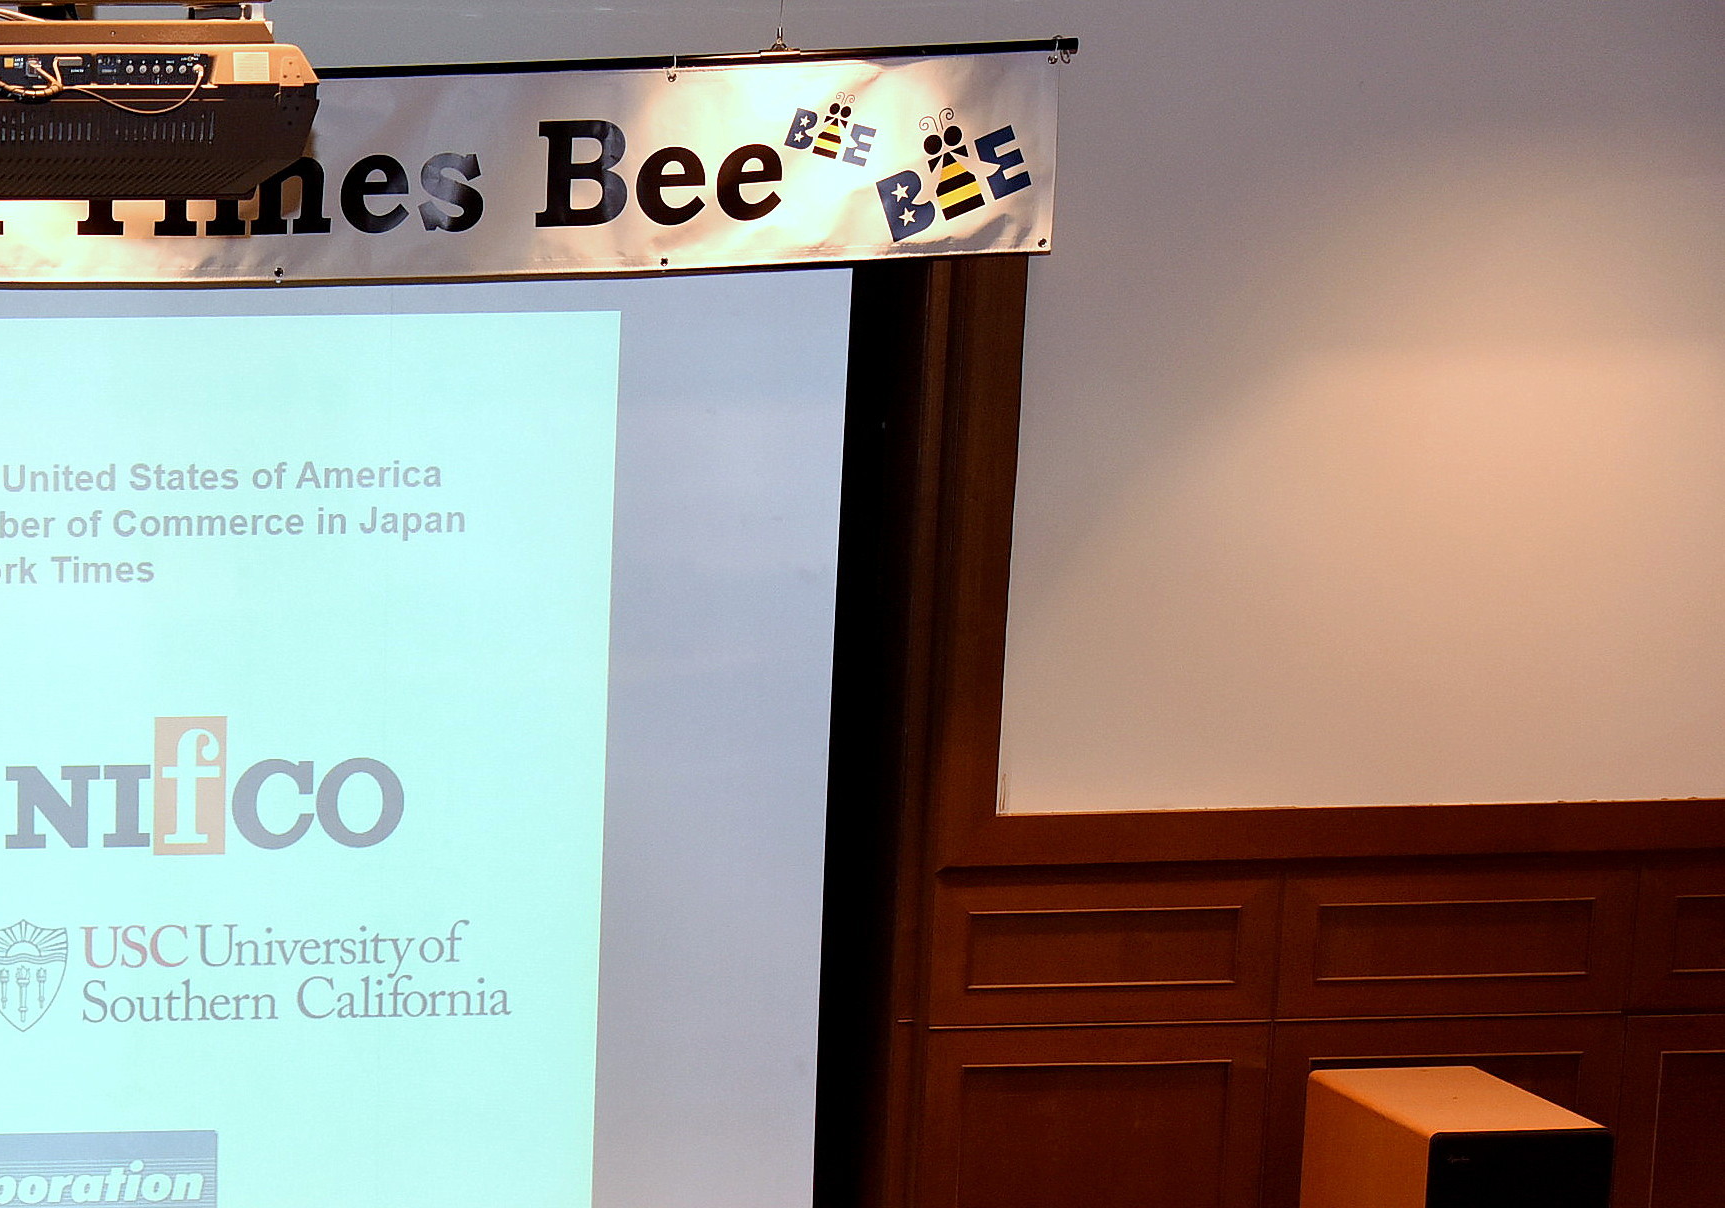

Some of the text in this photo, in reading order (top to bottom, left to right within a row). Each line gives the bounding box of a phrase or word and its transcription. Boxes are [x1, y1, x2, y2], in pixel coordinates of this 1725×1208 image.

[536, 119, 784, 230] Bee
[3, 464, 116, 491] United
[129, 463, 239, 491] States
[252, 462, 288, 489] of
[295, 460, 442, 490] America
[67, 510, 103, 537] of
[113, 509, 305, 538] Commerce
[317, 507, 347, 534] in
[358, 506, 466, 541] Japan
[50, 556, 154, 584] Times
[81, 918, 472, 970] USC University of
[81, 970, 513, 1024] Southern California
